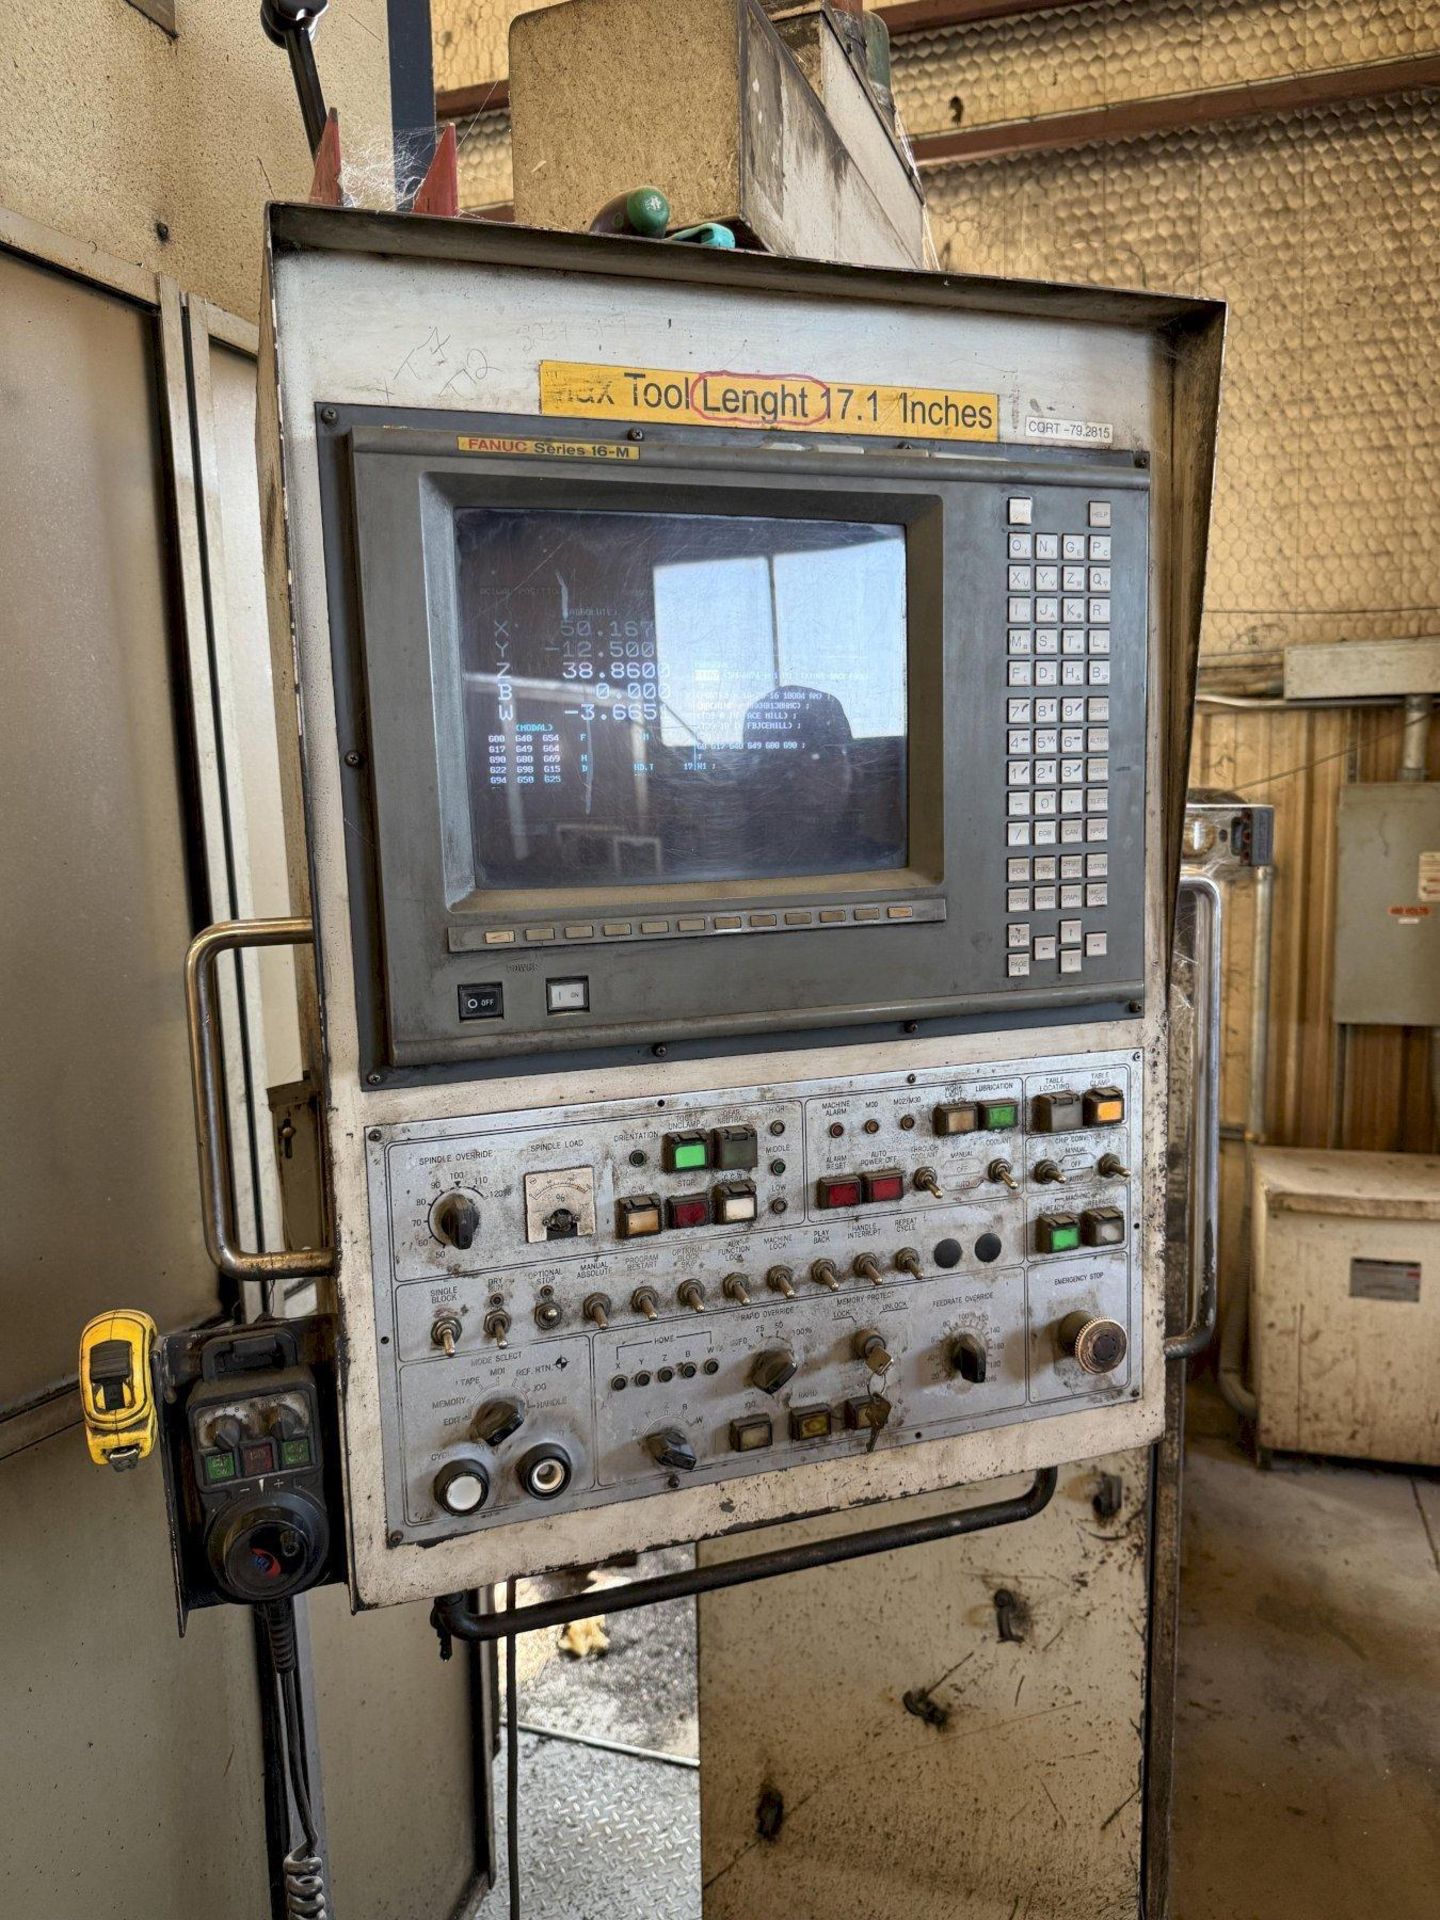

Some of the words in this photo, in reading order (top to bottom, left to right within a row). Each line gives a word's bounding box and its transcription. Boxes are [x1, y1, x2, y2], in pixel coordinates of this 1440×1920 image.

[624, 372, 691, 409] Tool
[703, 379, 809, 423] Lenght
[820, 387, 878, 421] 17.1
[902, 392, 993, 430] Inches
[468, 439, 527, 453] FANUC
[534, 443, 585, 456] Series
[592, 446, 630, 458] 16-M
[1039, 541, 1048, 552] N
[1066, 541, 1075, 553] G
[1092, 542, 1101, 552] P
[1013, 572, 1020, 583] X
[1040, 572, 1048, 583] Y
[1067, 573, 1075, 584] Z
[1092, 573, 1102, 585] Q
[1040, 604, 1048, 615] J
[1067, 604, 1074, 615] K
[1093, 604, 1101, 615] R
[494, 620, 510, 637] X
[1012, 636, 1021, 647] M
[1039, 635, 1047, 646] S
[1066, 635, 1074, 646] T
[1093, 636, 1100, 646] L
[495, 641, 510, 658] Y
[496, 662, 512, 679] Z
[1012, 668, 1020, 678] F
[1039, 667, 1047, 678] D
[1066, 667, 1074, 678] H
[1093, 667, 1100, 677] B
[498, 684, 512, 701] B
[499, 705, 513, 721] W
[1011, 706, 1019, 717] 7
[1038, 705, 1046, 716] 8
[1065, 705, 1073, 716] 9
[1010, 737, 1018, 748] 4
[1038, 737, 1046, 748] 5
[1064, 736, 1072, 747] 6
[1037, 768, 1045, 778] 2
[1064, 766, 1072, 777] 3
[530, 1141, 561, 1152] SPINDLE
[564, 1138, 584, 1148] LOAD
[419, 1154, 452, 1166] SPINDLE
[455, 1150, 493, 1162] OVERRIDE
[450, 1171, 464, 1179] 100
[474, 1176, 488, 1184] 110
[412, 1218, 422, 1226] 70
[436, 1250, 446, 1258] 50
[580, 1261, 609, 1271] MANUAL
[576, 1268, 612, 1279] ABSOLUTE
[1054, 1275, 1088, 1285] EMERGENCY
[430, 1286, 457, 1297] SINGLE
[933, 1296, 962, 1307] FEEDRATE
[965, 1292, 993, 1303] OVERRIDE
[762, 1306, 794, 1318] OVERRIDE
[654, 1335, 674, 1344] HOME
